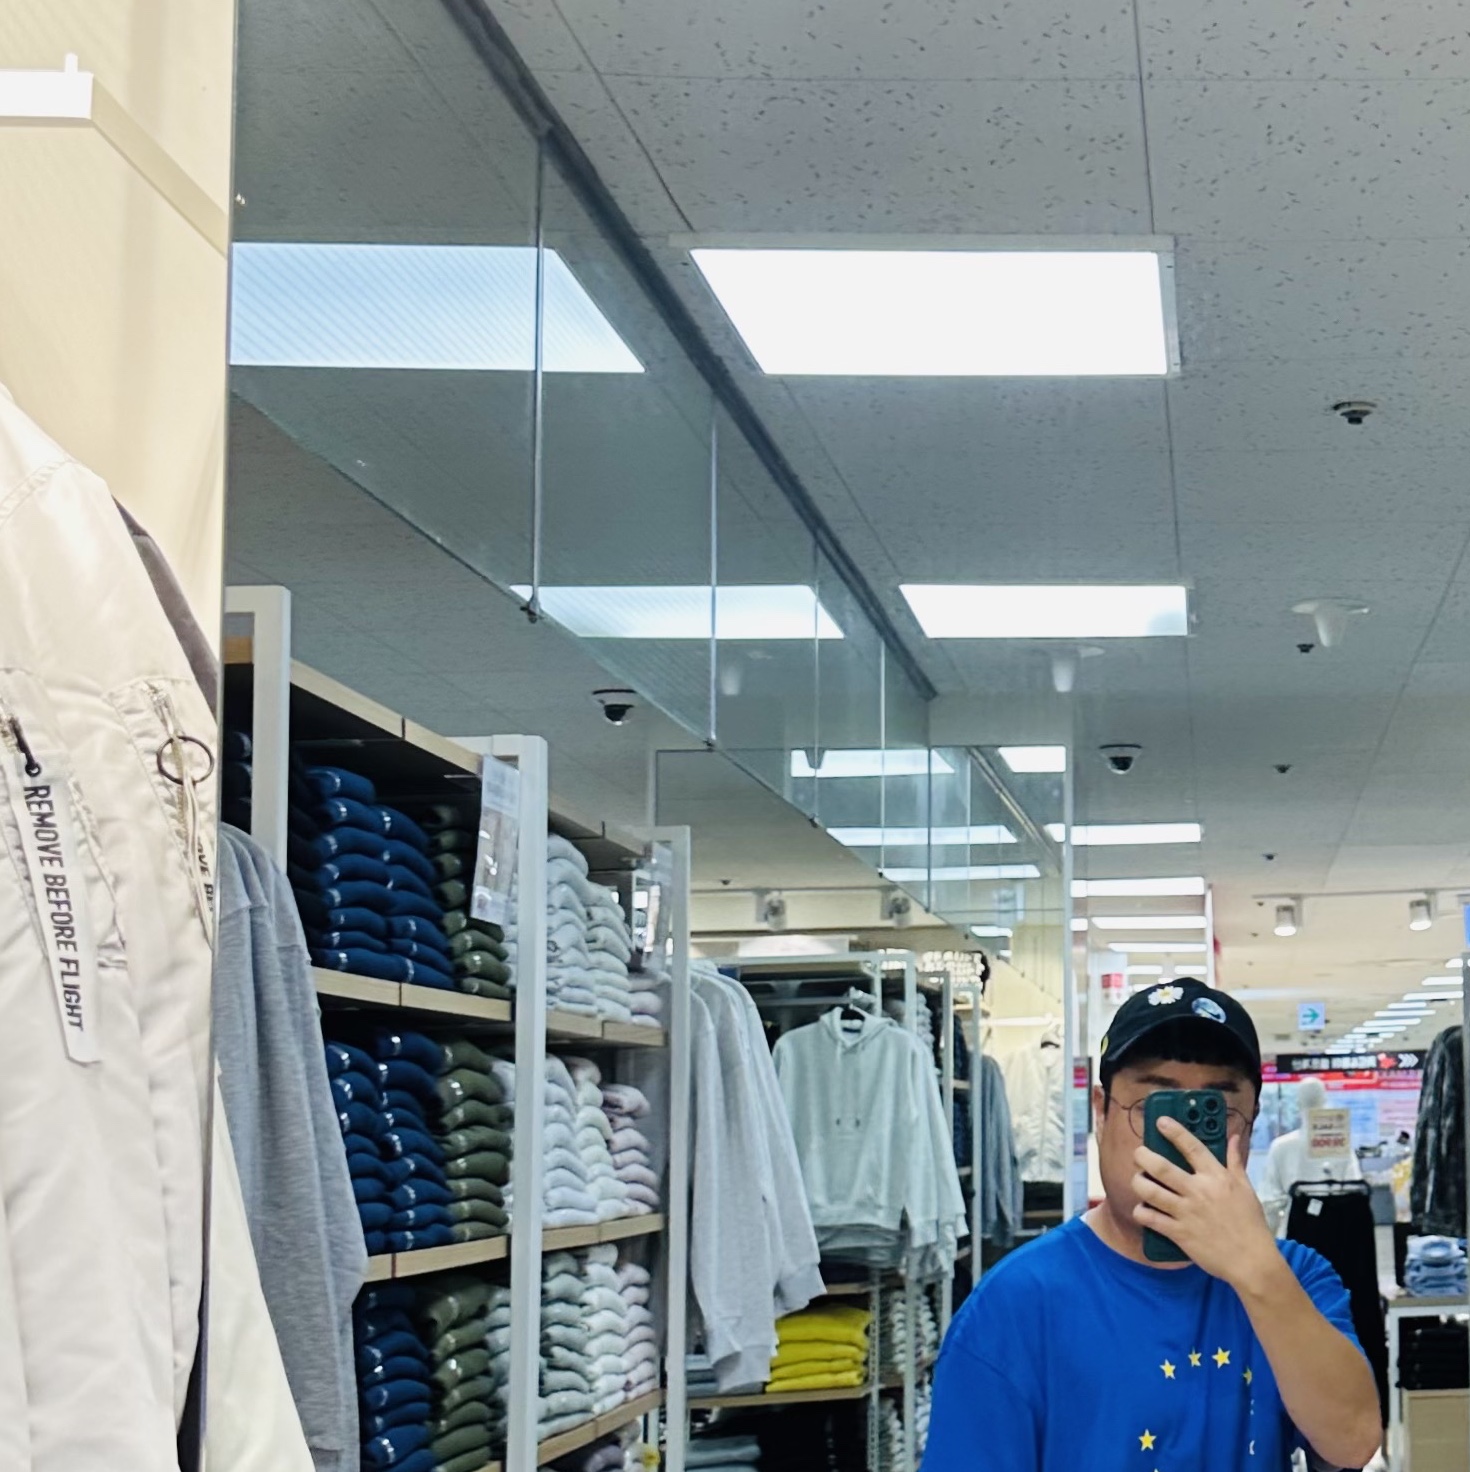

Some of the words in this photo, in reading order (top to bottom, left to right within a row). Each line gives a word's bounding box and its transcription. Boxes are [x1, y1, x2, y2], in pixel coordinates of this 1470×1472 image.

[24, 785, 64, 868] REMOVE
[43, 872, 78, 952] BEFORE
[59, 957, 84, 1032] FLIGHT
